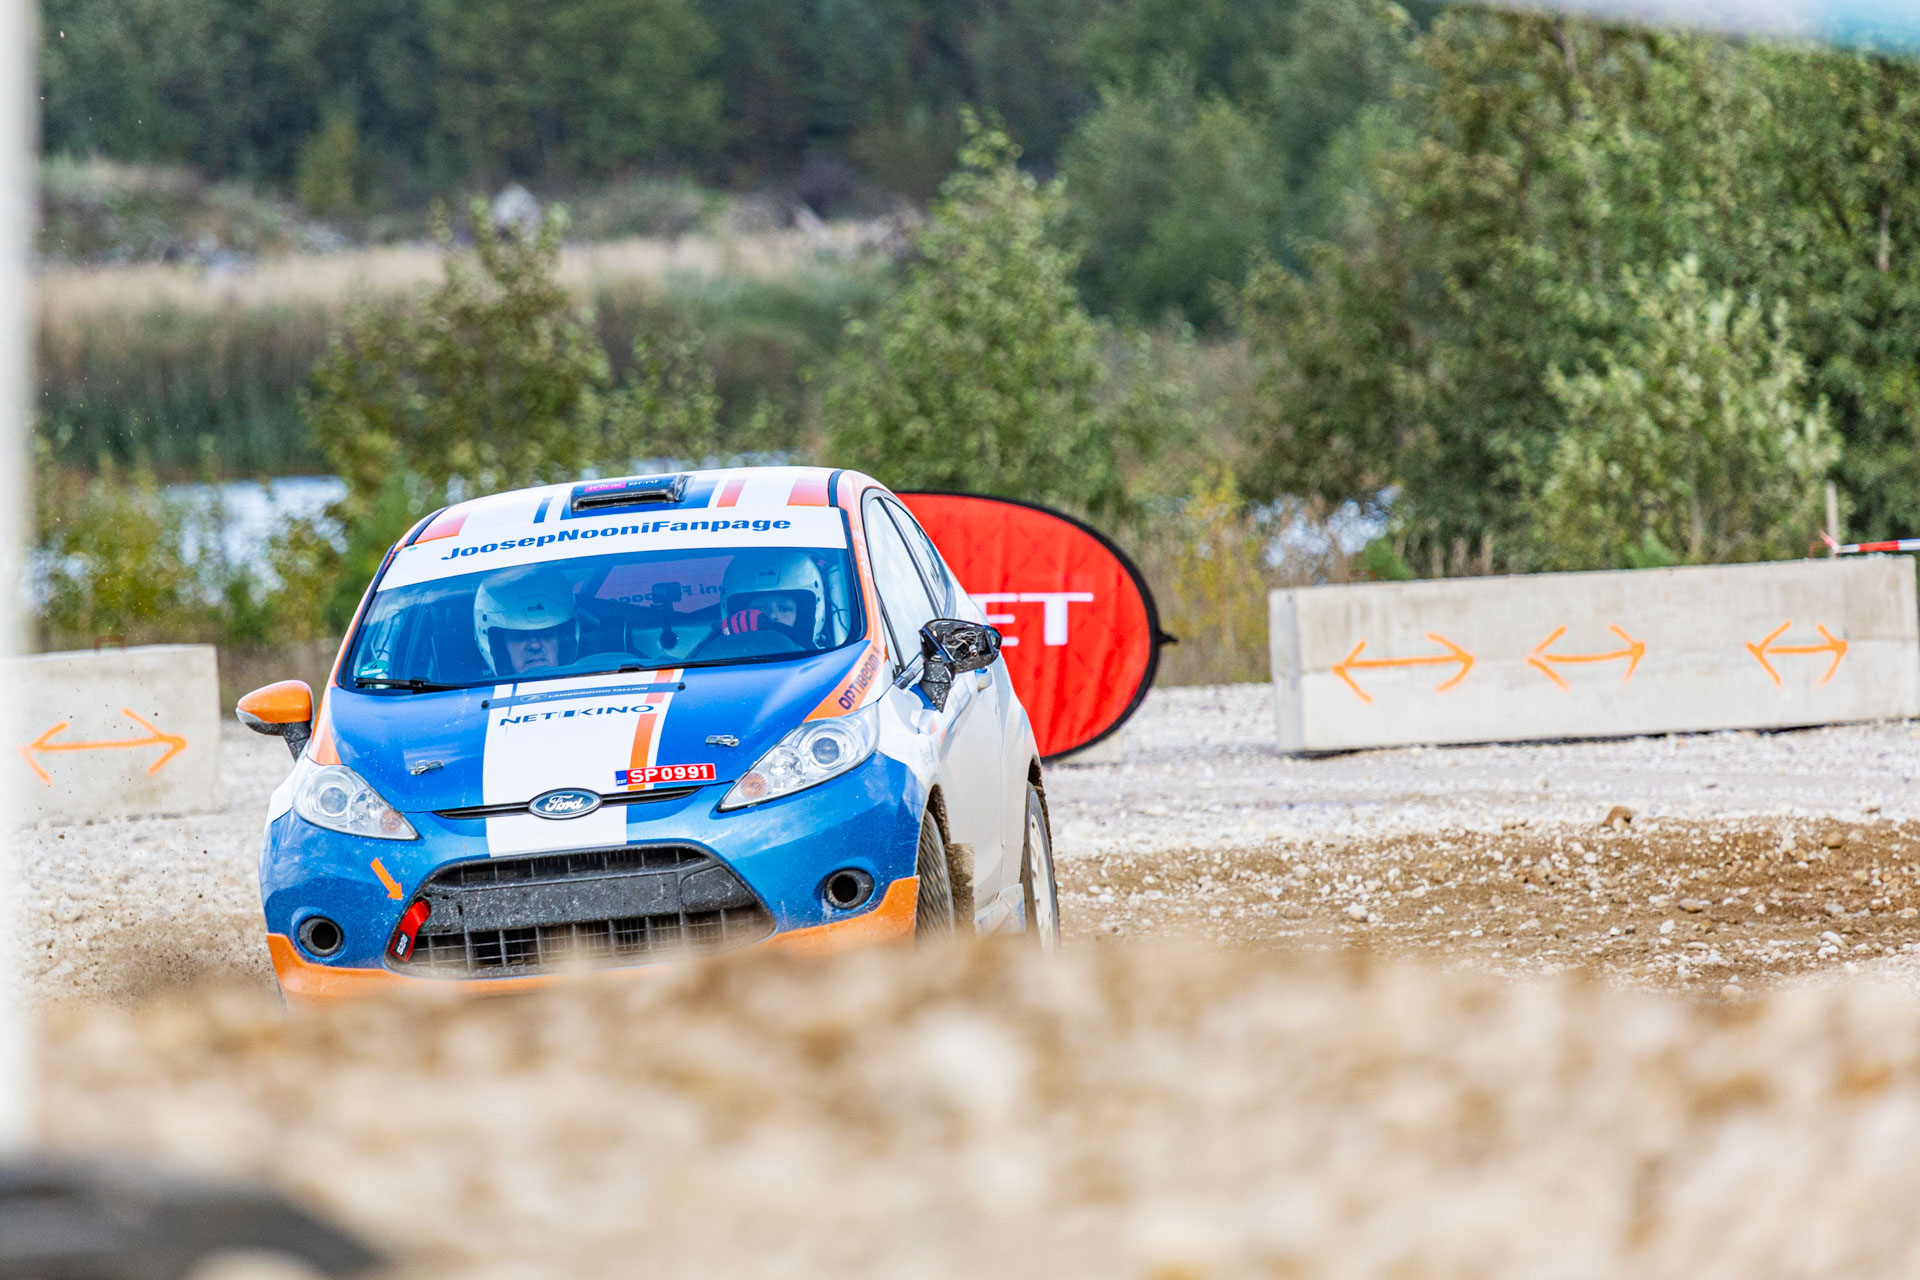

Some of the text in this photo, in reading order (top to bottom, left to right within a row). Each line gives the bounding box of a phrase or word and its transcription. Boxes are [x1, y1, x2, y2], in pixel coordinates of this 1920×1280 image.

[441, 519, 791, 561] JoosepNooniFanpage
[969, 591, 1095, 647] ET
[545, 794, 584, 812] Ford
